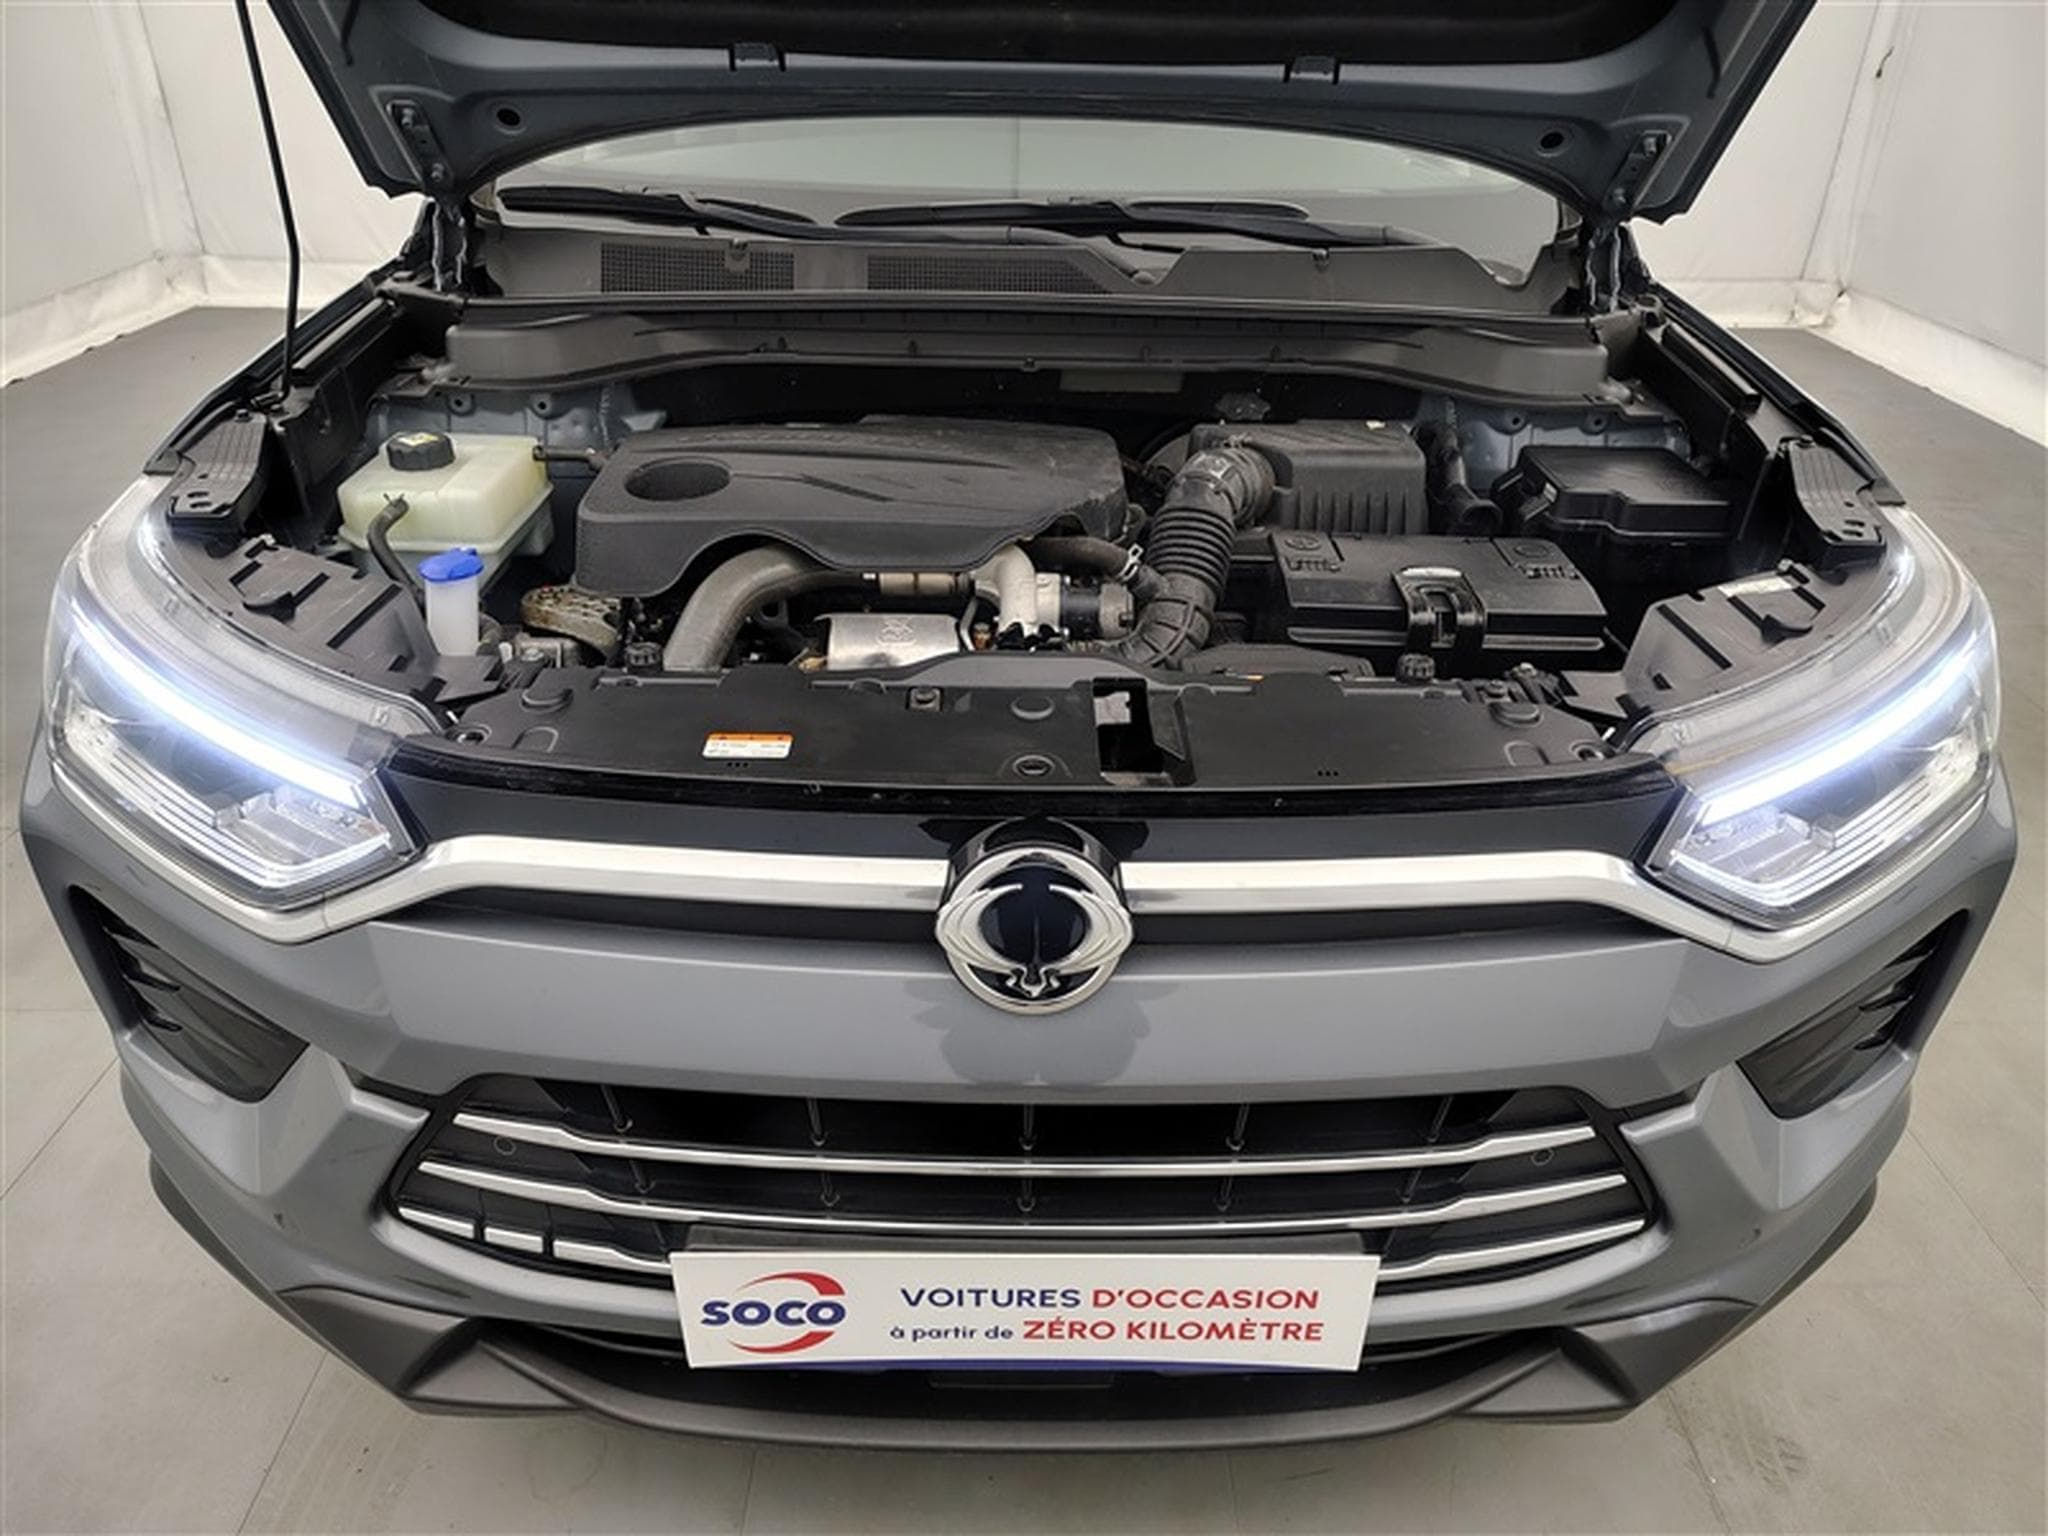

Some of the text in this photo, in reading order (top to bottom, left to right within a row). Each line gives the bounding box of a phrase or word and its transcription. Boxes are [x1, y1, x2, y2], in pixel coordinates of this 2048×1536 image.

[900, 1288, 1319, 1310] VOITURES D'OCCASION
[700, 1300, 847, 1327] SOCO
[889, 1316, 1325, 1342] à partir de ZÉRO KILOMÈTRE
